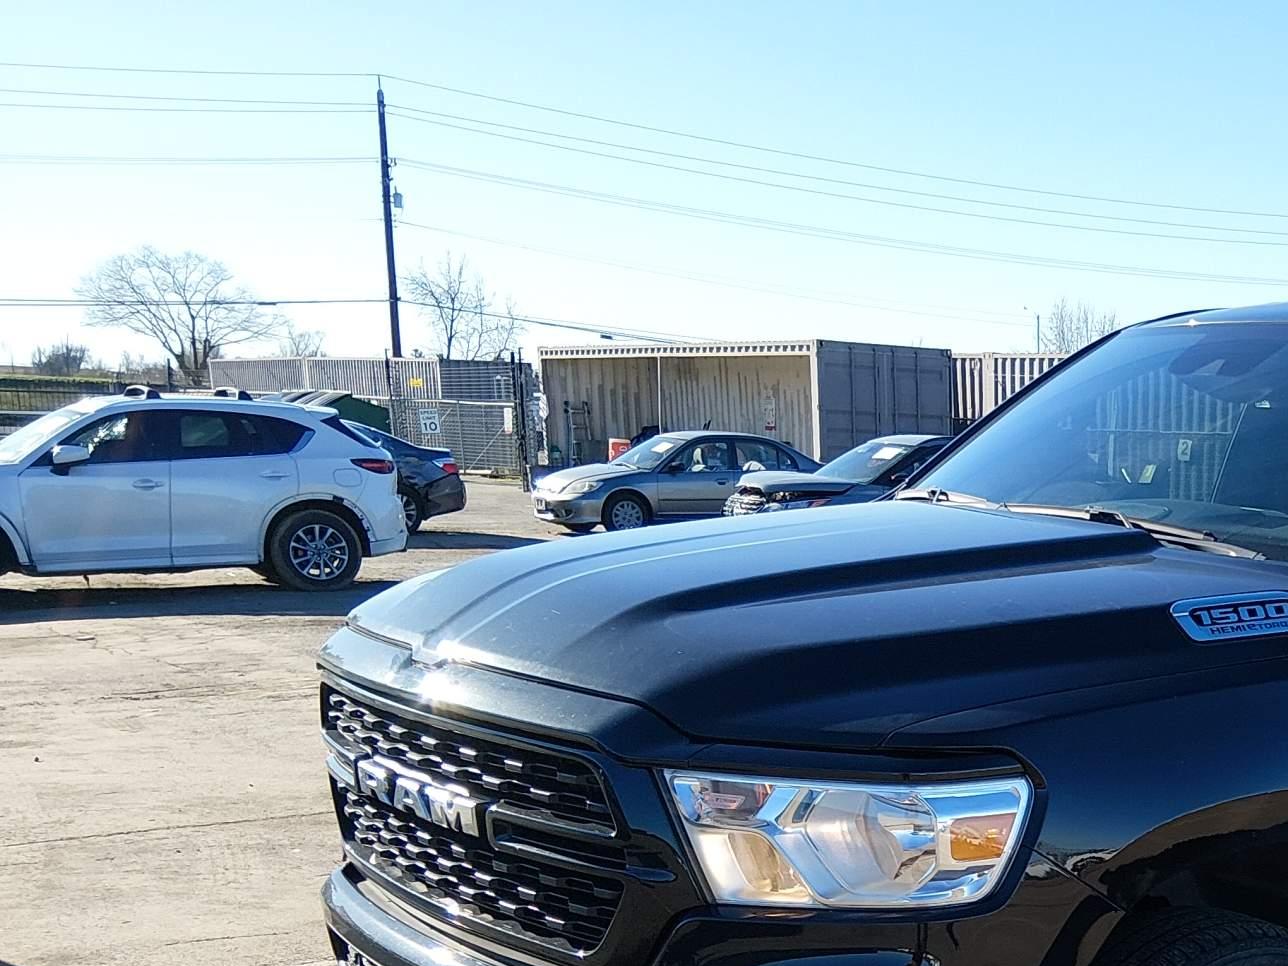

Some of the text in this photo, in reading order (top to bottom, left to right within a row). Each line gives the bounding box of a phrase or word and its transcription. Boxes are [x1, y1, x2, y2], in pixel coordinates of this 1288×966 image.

[423, 421, 438, 432] 10
[1180, 441, 1189, 456] 2
[357, 754, 480, 838] RAM
